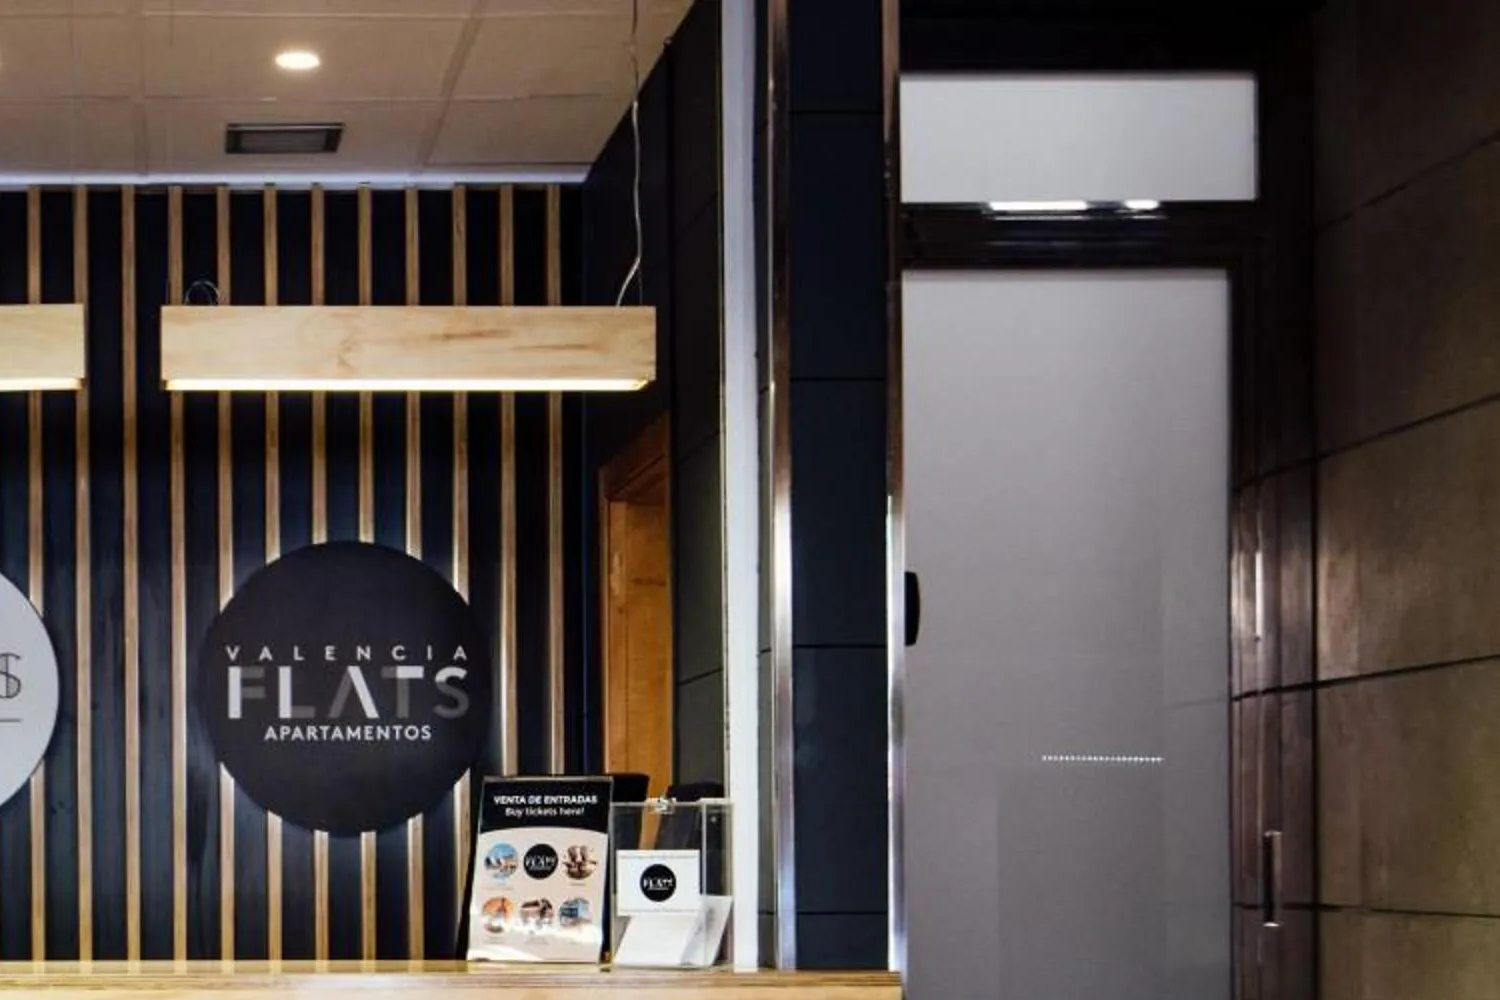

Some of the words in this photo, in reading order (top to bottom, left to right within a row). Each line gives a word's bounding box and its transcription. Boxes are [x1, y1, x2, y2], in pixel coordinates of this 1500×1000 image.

[226, 645, 468, 661] VALENCIA
[228, 665, 470, 719] FLATS
[264, 725, 432, 741] APARTAMENTOS
[493, 795, 526, 805] VENTA
[527, 795, 542, 804] DE
[543, 795, 598, 804] ENTRADAS
[505, 807, 524, 818] Buy
[525, 807, 557, 816] tickets
